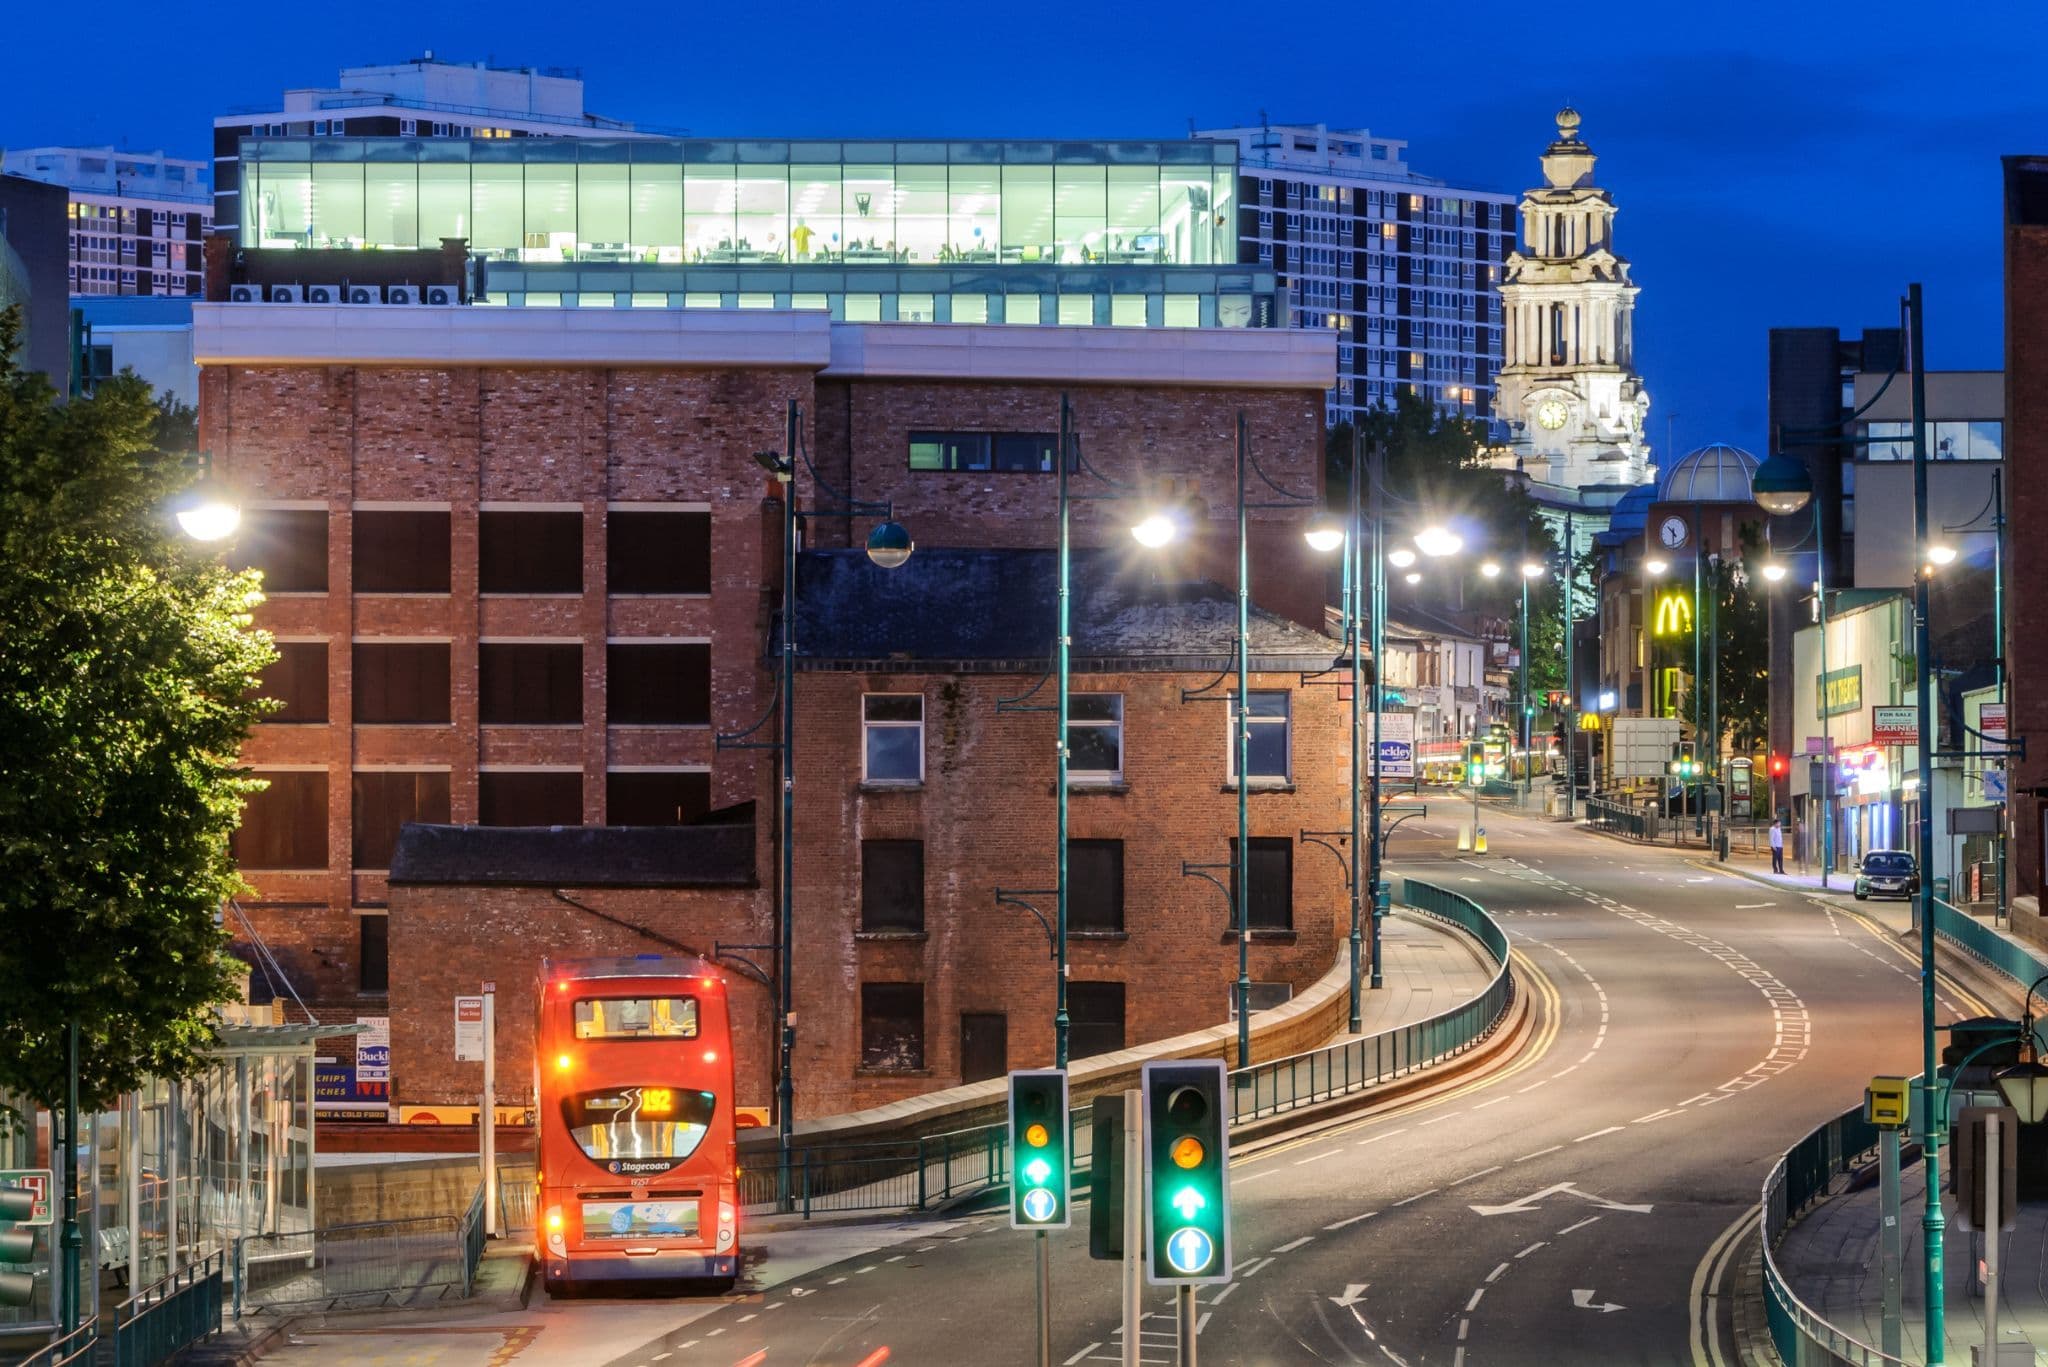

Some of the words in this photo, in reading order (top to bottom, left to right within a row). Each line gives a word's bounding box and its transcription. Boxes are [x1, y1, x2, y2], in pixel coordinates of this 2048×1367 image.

[360, 1050, 389, 1062] Buckl
[317, 1088, 346, 1096] ICHES
[642, 1089, 671, 1112] 192
[622, 1161, 670, 1173] Stagecoach
